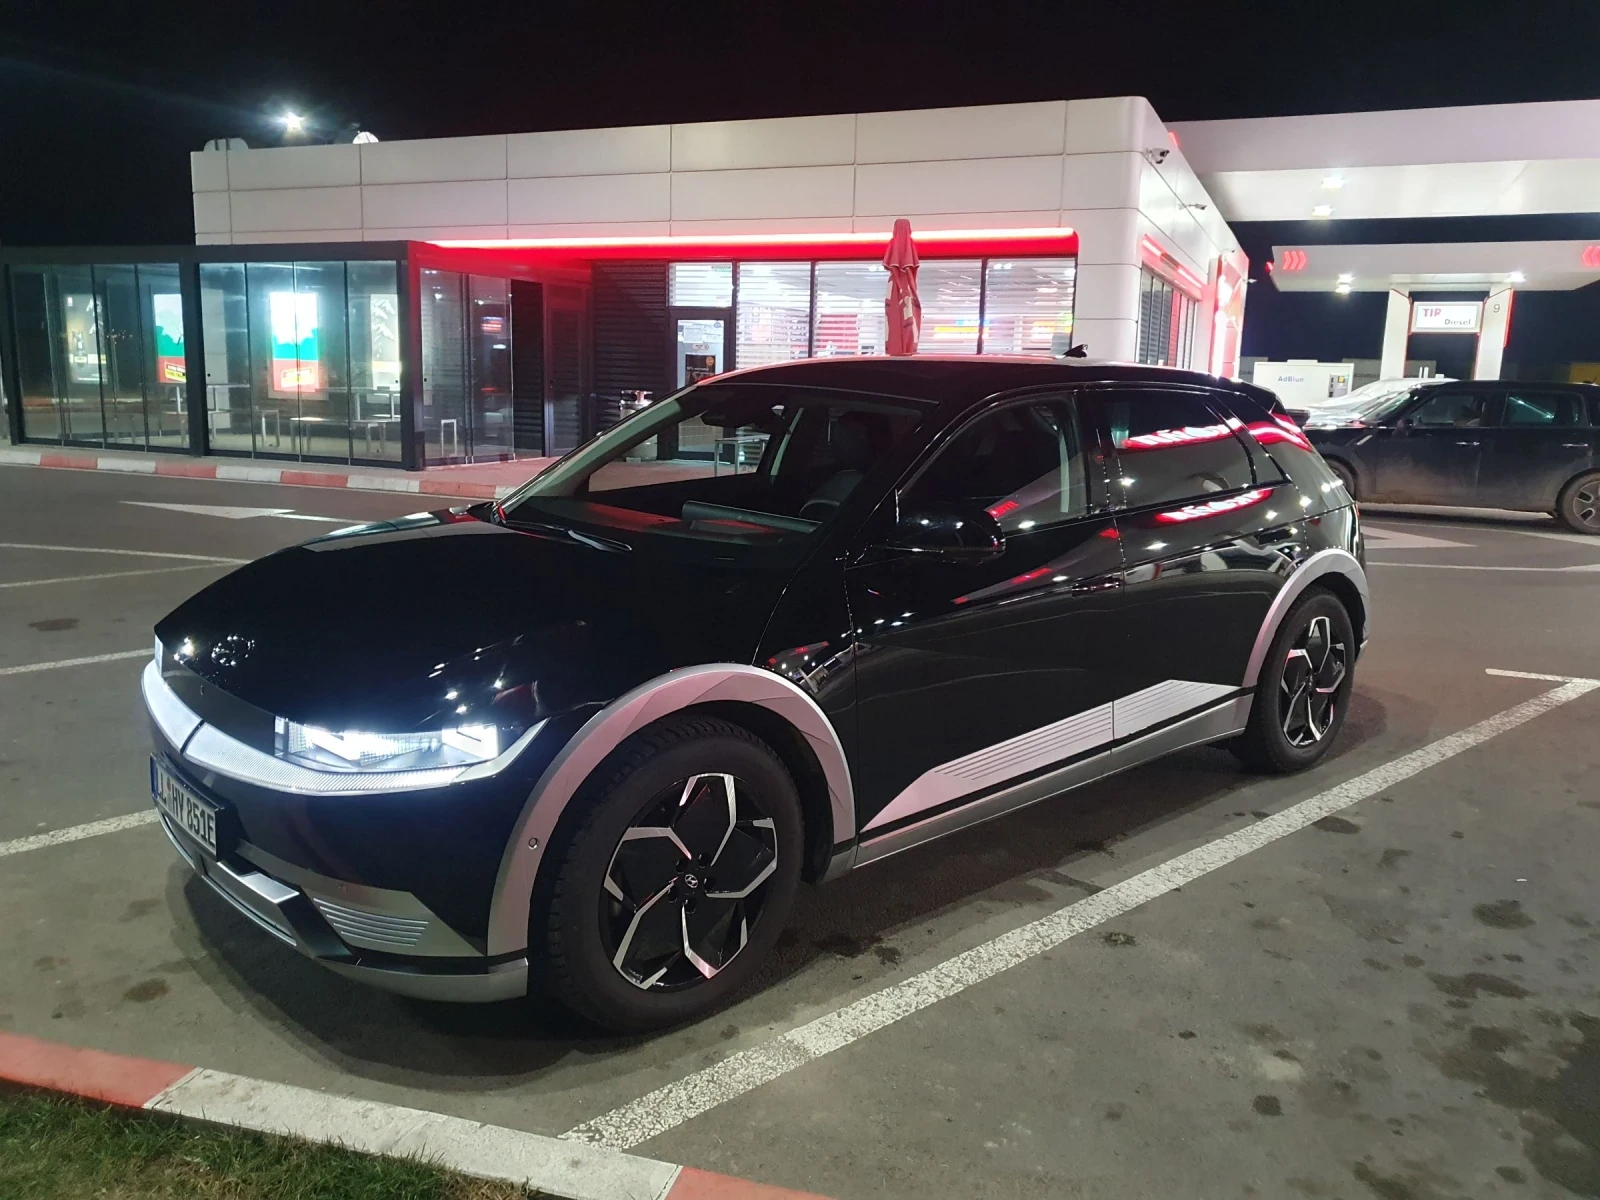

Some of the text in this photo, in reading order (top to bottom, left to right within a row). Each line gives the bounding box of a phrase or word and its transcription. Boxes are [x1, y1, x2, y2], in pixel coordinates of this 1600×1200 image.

[1494, 303, 1501, 313] 9
[1444, 318, 1471, 326] Diesel
[1278, 375, 1304, 383] AdBlue
[186, 797, 216, 849] 851E
